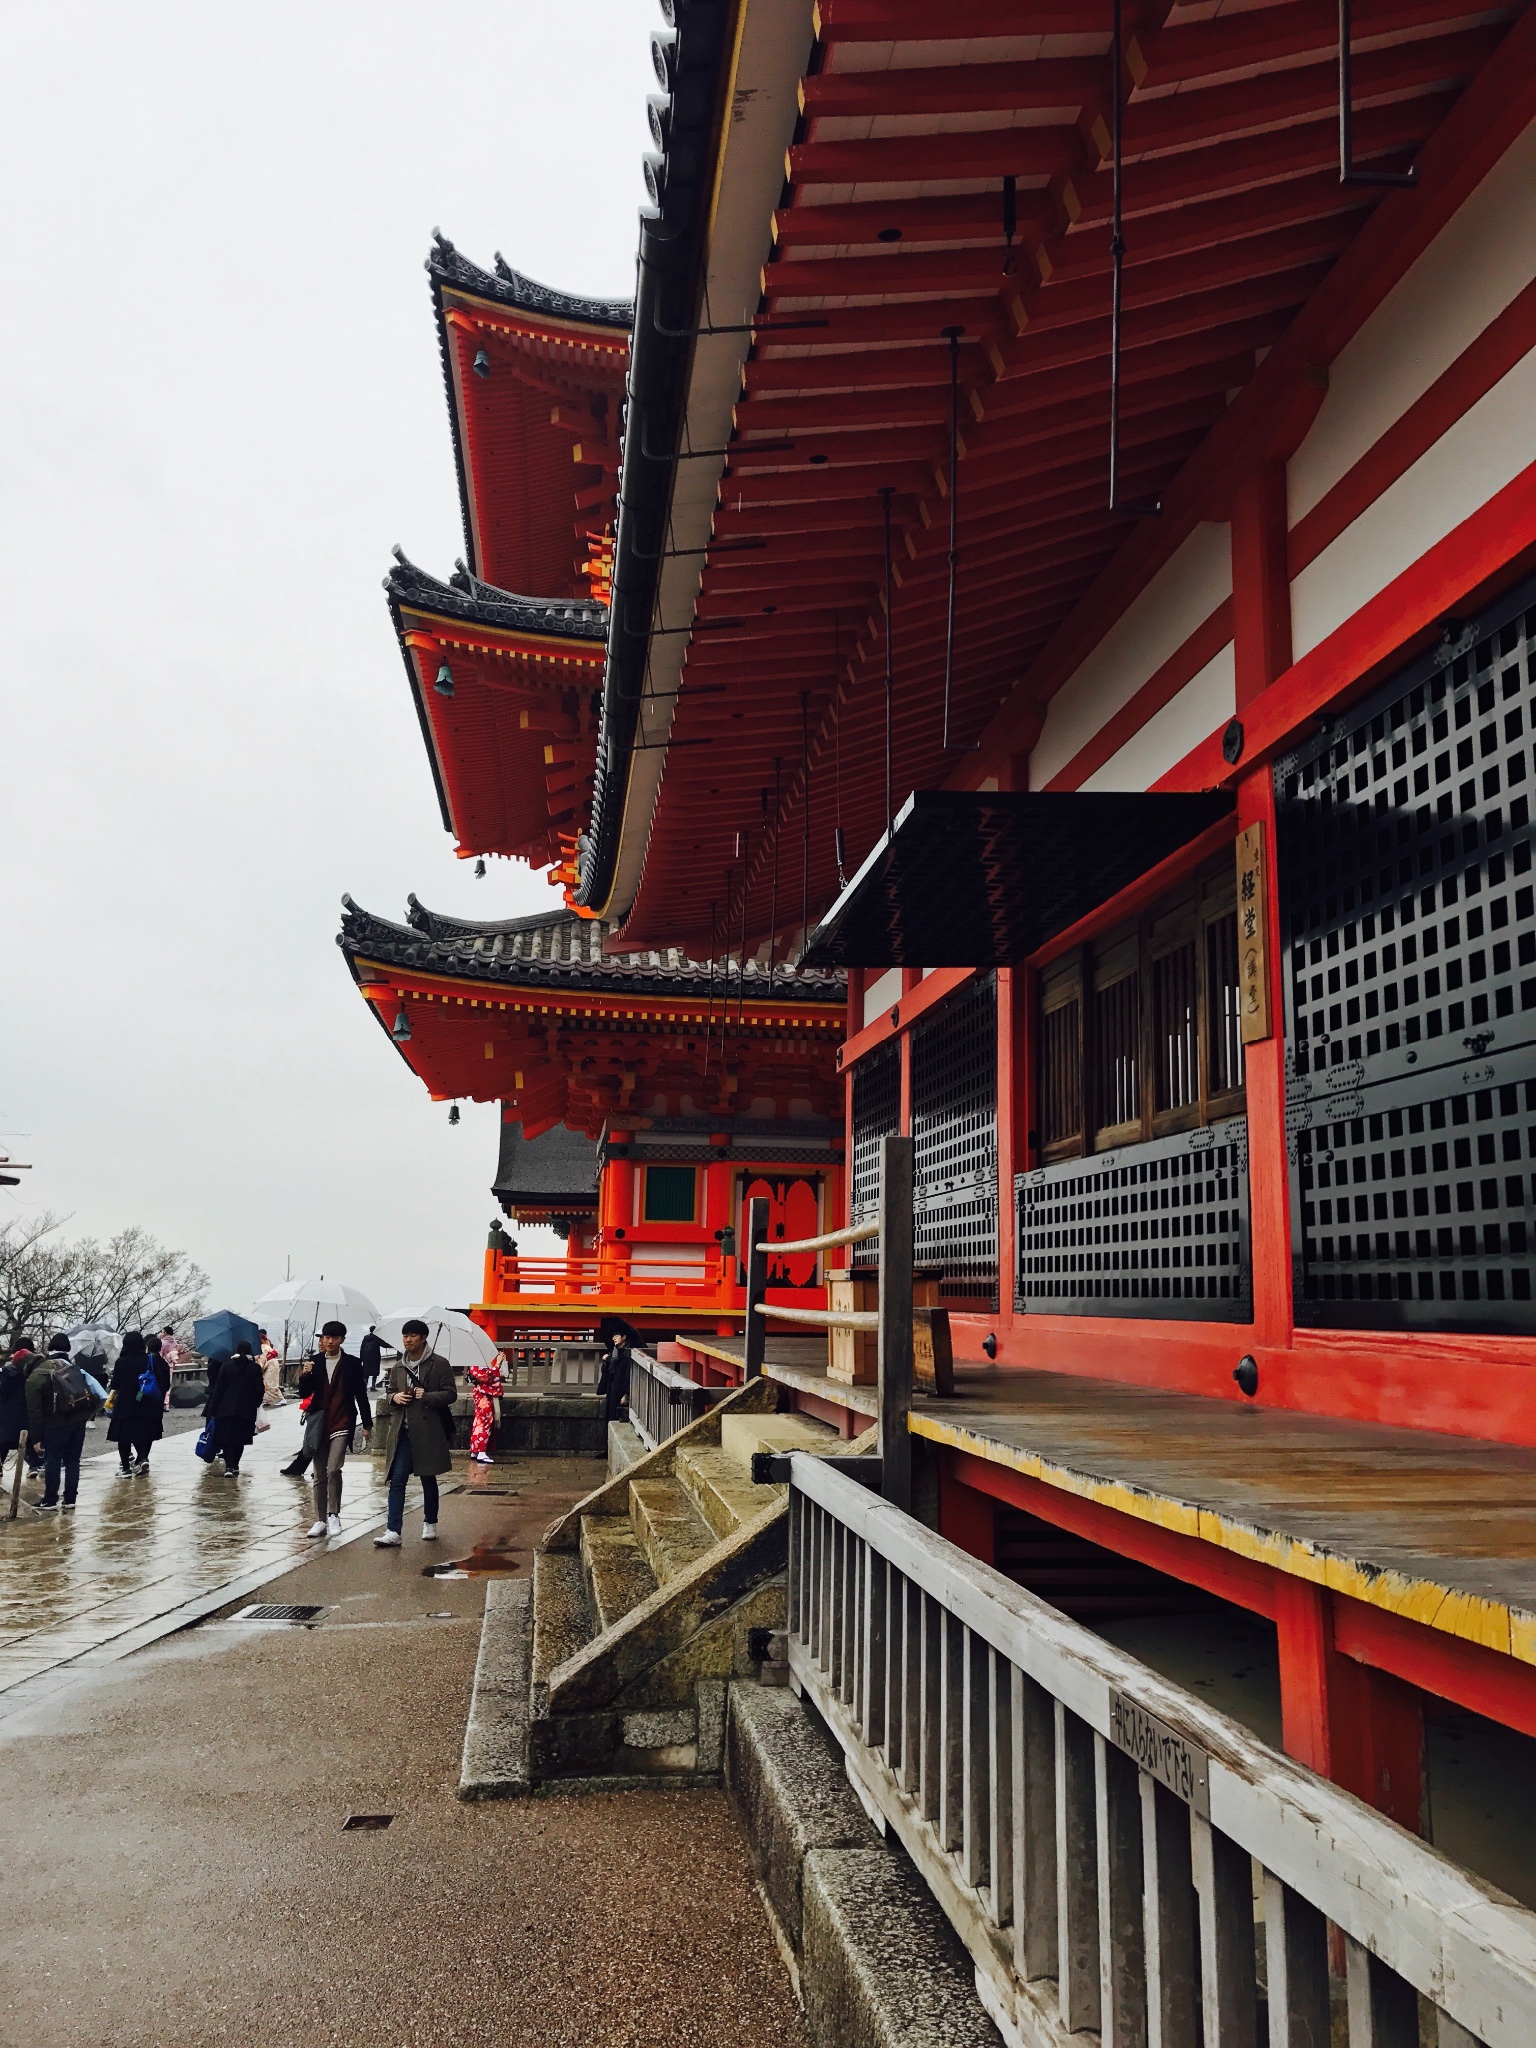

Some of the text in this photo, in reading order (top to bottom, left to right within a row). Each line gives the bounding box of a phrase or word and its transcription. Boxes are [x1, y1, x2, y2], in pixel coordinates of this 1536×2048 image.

[1114, 1692, 1194, 1799] 中に入らないで下さい
